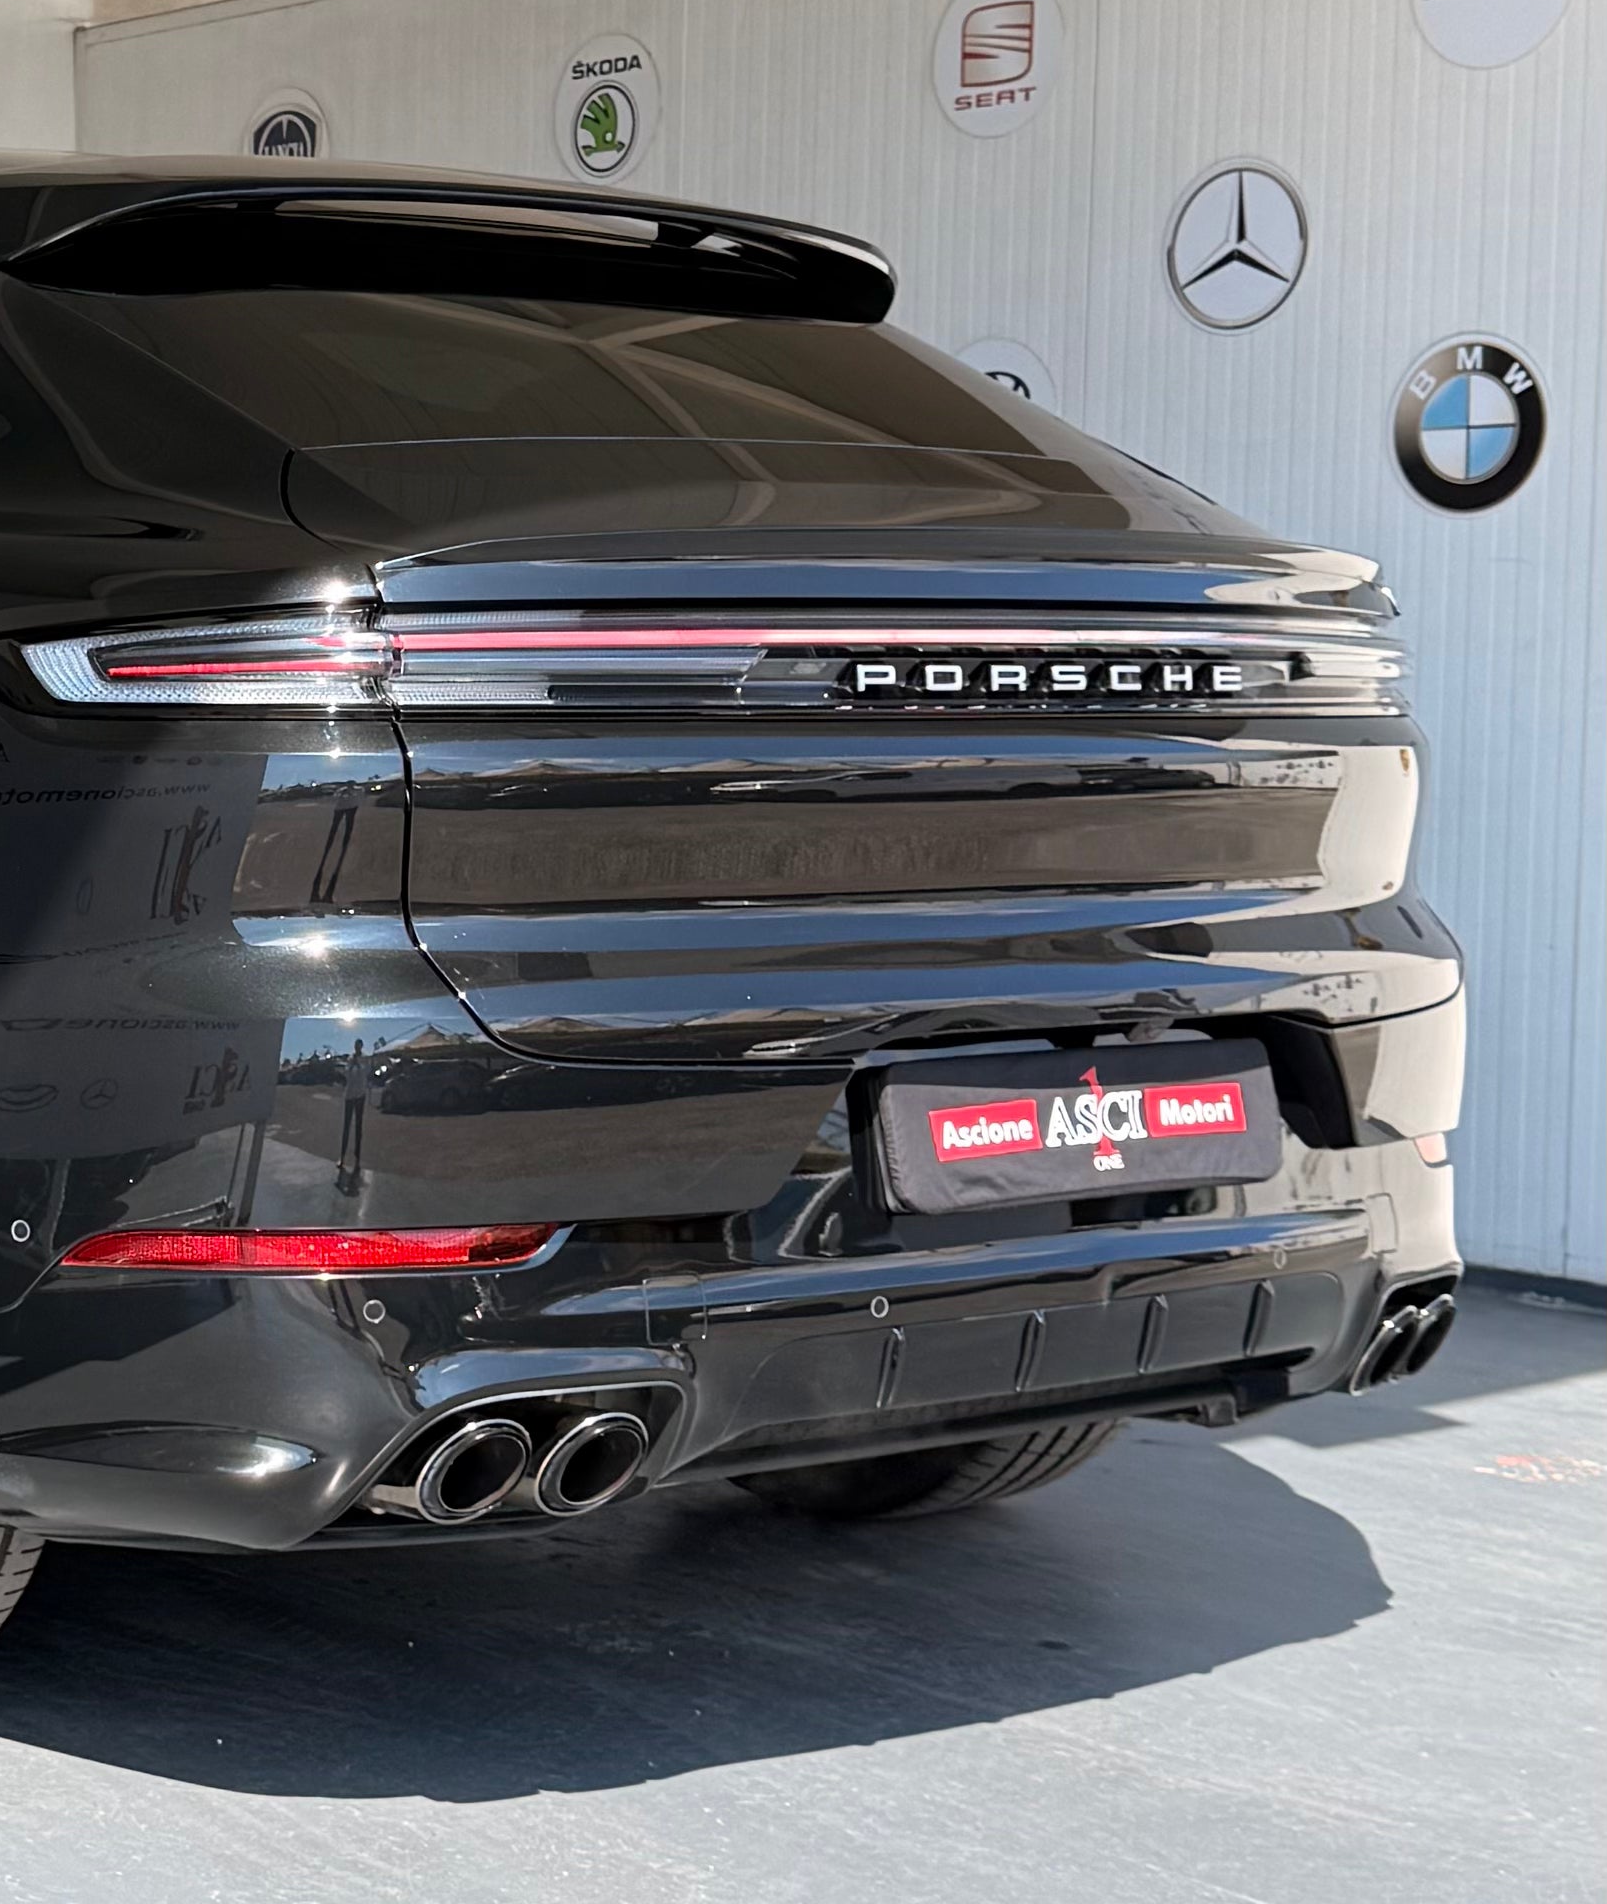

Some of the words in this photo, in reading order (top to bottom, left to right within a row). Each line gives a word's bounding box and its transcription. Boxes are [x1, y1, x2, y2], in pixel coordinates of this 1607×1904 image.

[571, 54, 642, 80] ŠKODA
[954, 86, 1037, 112] SEAT
[1409, 345, 1534, 400] BMW
[856, 664, 1243, 692] PORSCHE
[943, 1116, 1034, 1151] Ascione
[1045, 1090, 1149, 1148] ASCI
[1159, 1094, 1235, 1126] Motori
[1093, 1154, 1126, 1171] ONE
